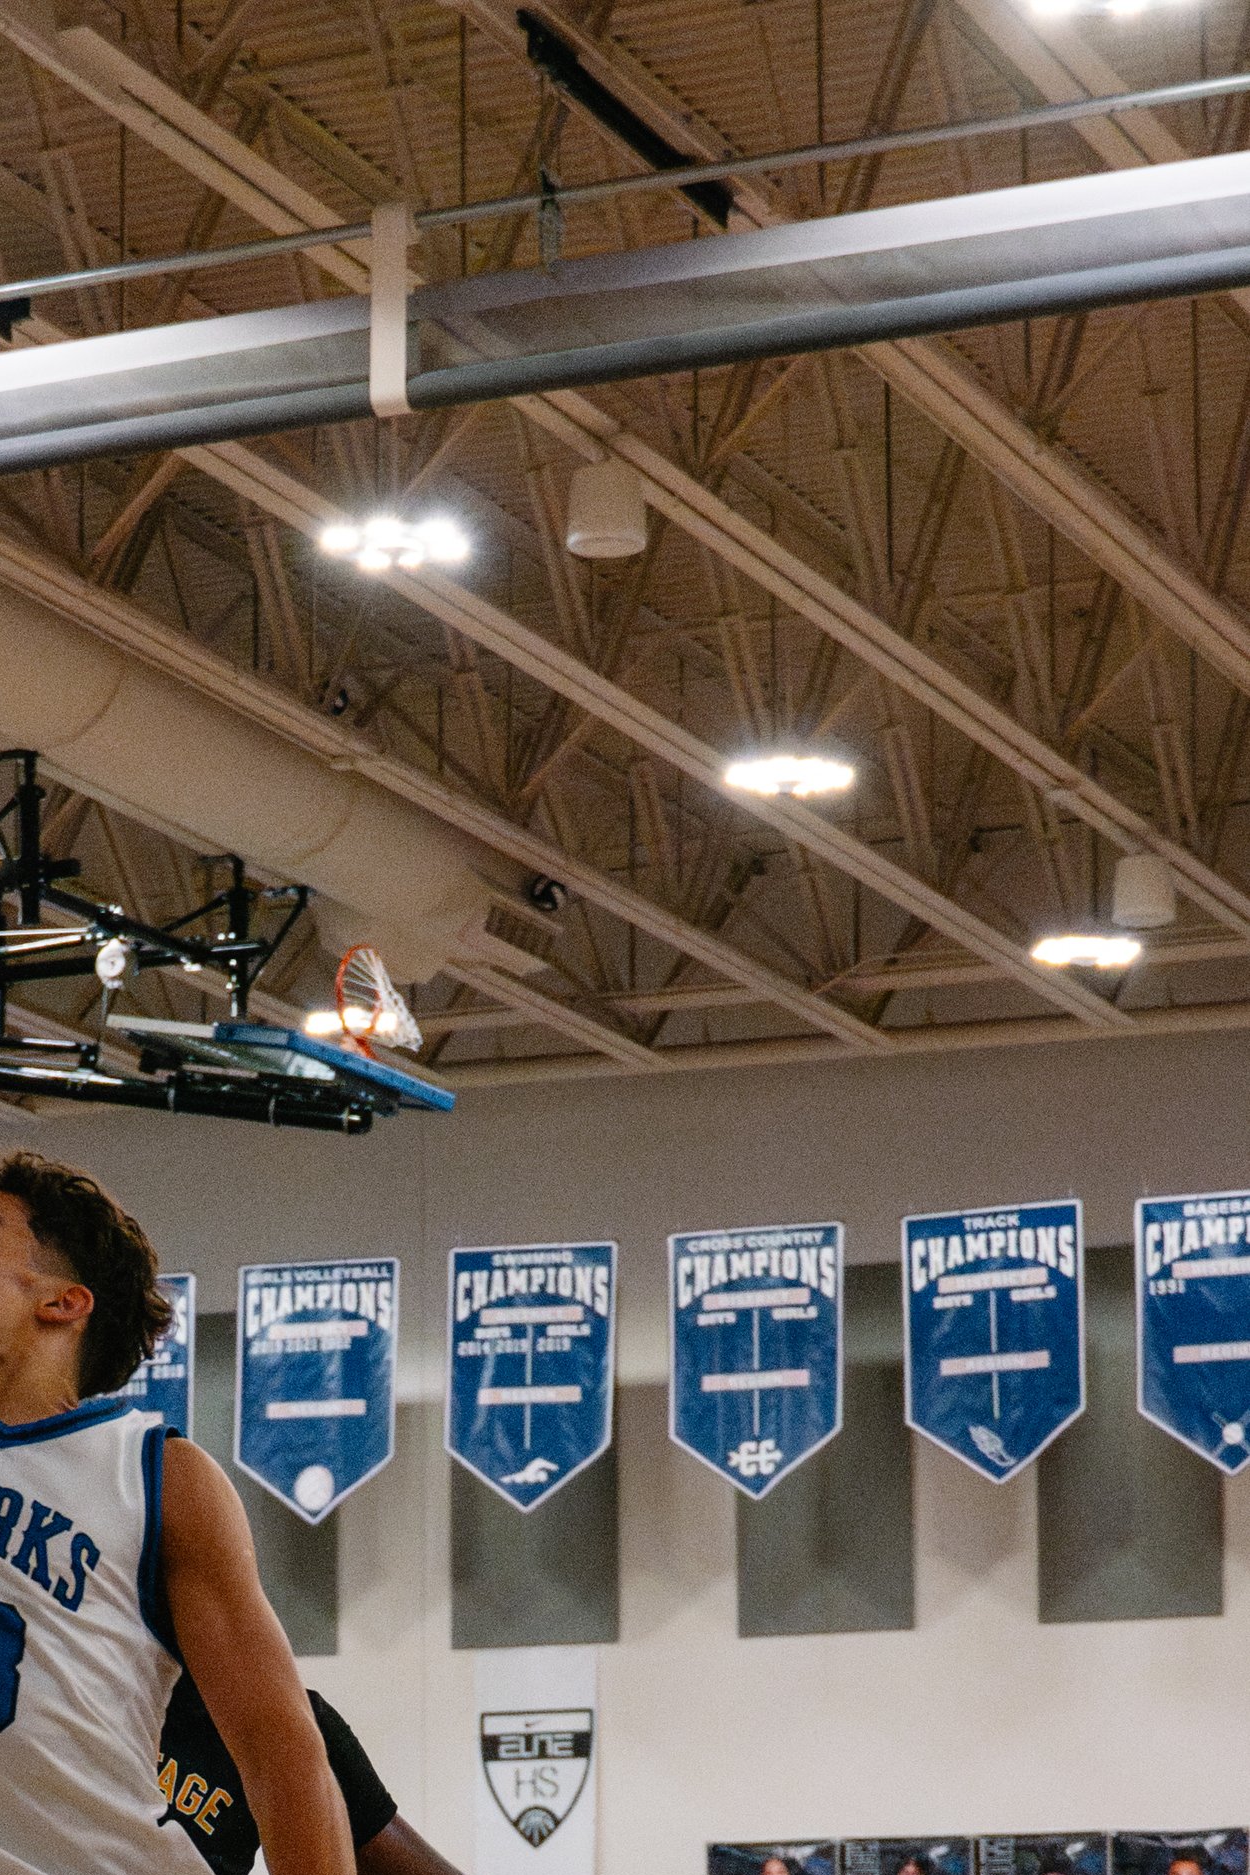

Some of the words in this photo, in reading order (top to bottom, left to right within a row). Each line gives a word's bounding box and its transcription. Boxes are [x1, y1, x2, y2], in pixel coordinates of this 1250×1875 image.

[686, 1236, 745, 1253] CROSS
[745, 1231, 824, 1248] COUNTRY
[962, 1213, 1020, 1232] TRACK
[294, 1265, 391, 1282] VOLLEYBALL
[677, 1246, 836, 1310] CHAMPIONS
[911, 1224, 1075, 1293] CHAMPIONS
[246, 1280, 391, 1338] CHAMPIONS
[455, 1265, 609, 1323] CHAMPIONS
[514, 1766, 559, 1800] HS
